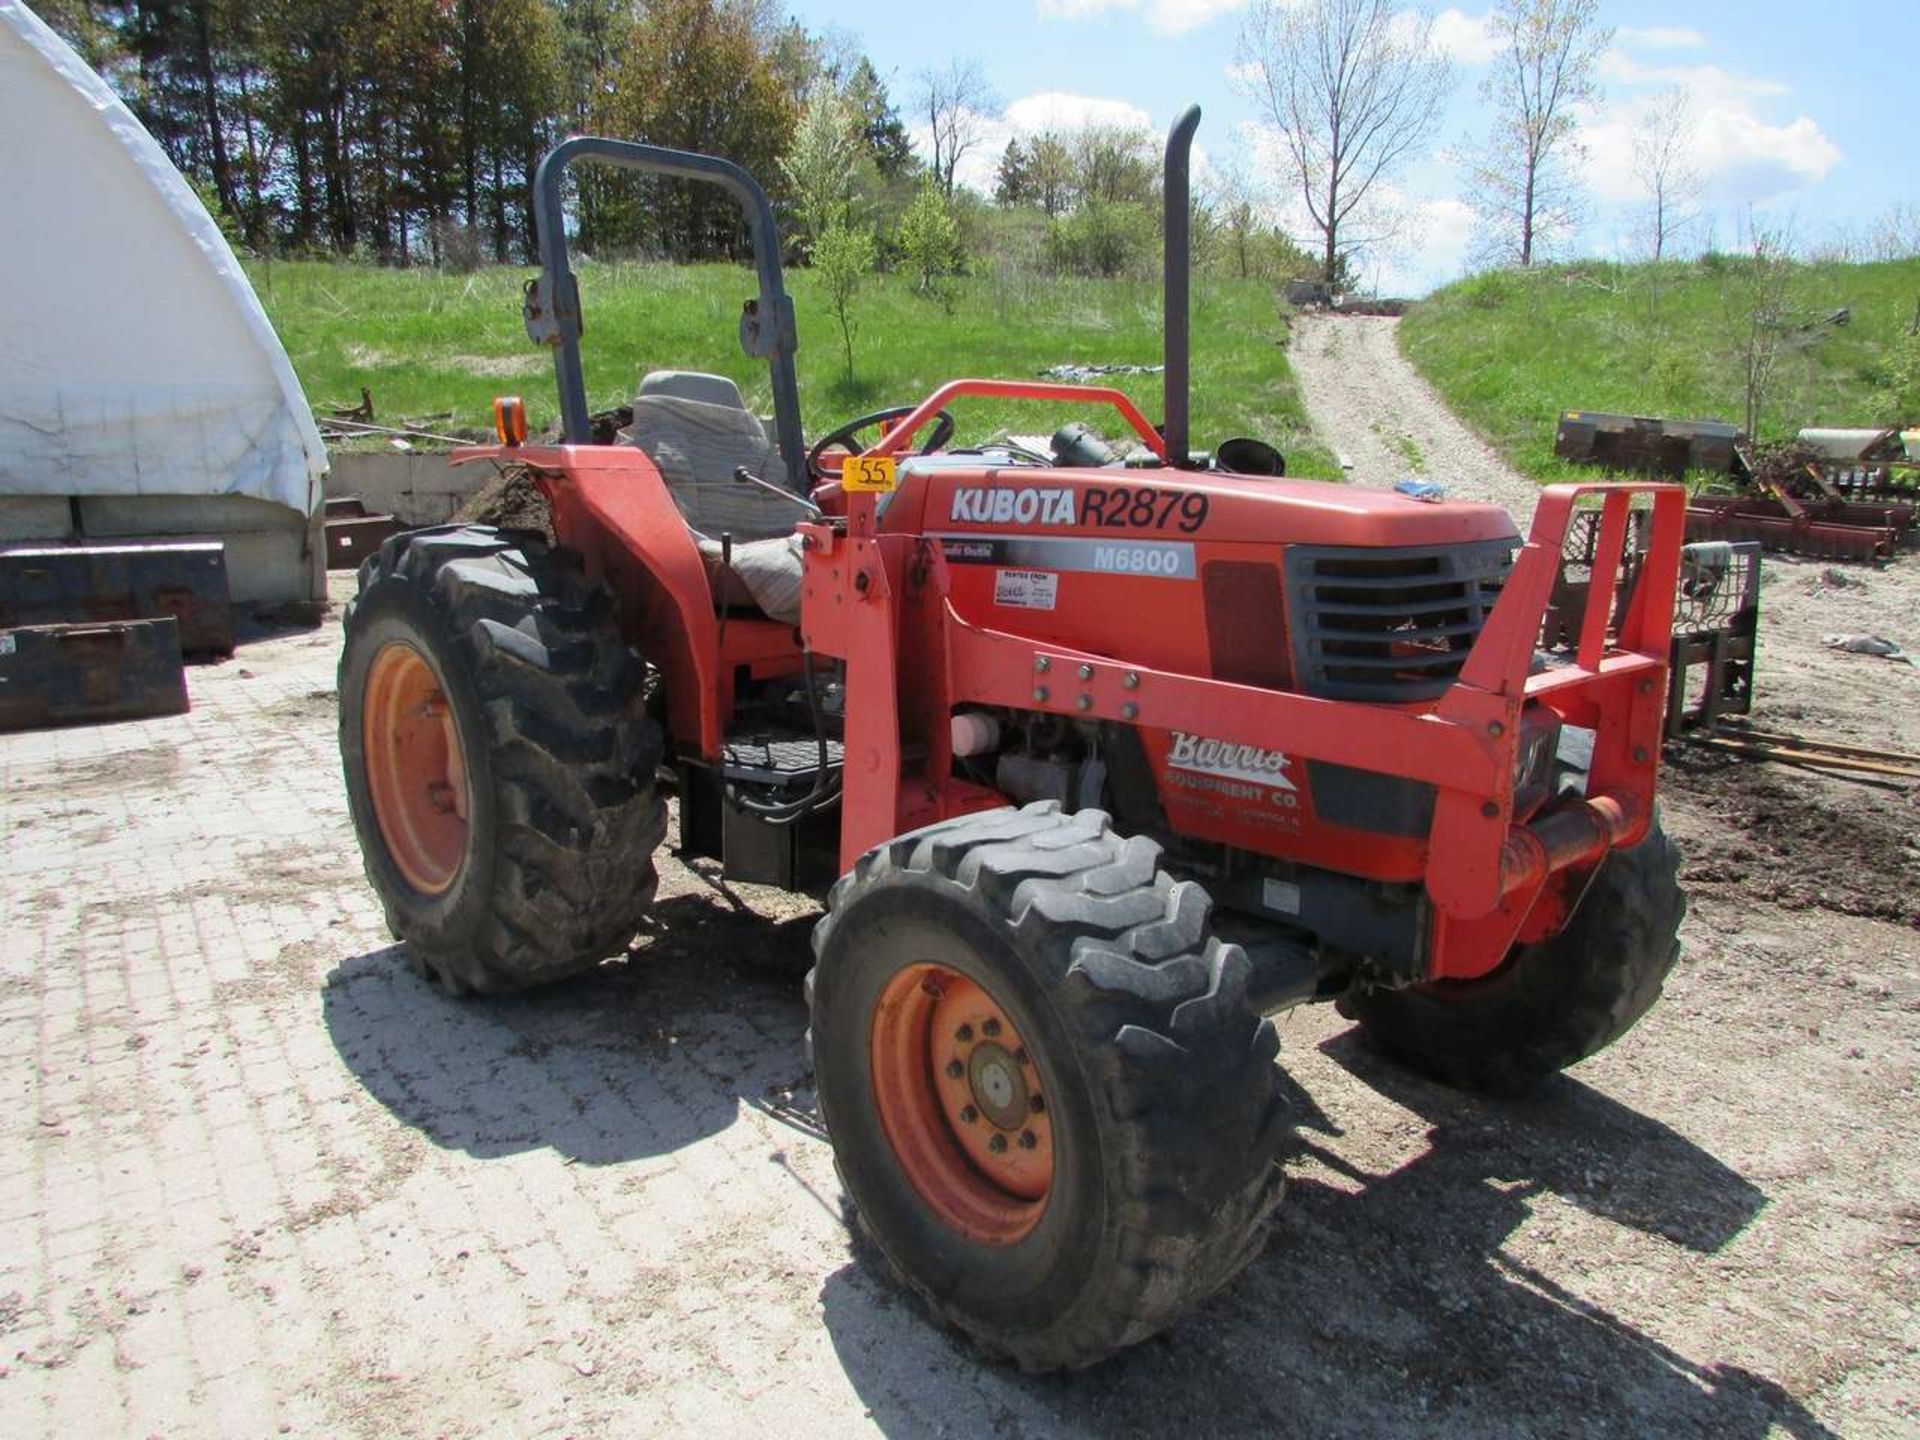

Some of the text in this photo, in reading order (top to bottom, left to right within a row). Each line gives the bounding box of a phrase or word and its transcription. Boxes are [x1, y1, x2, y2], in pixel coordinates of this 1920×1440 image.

[858, 460, 886, 483] 55
[950, 488, 1077, 526] KUBOTA
[1080, 487, 1210, 533] R2879
[1094, 547, 1180, 574] M6800
